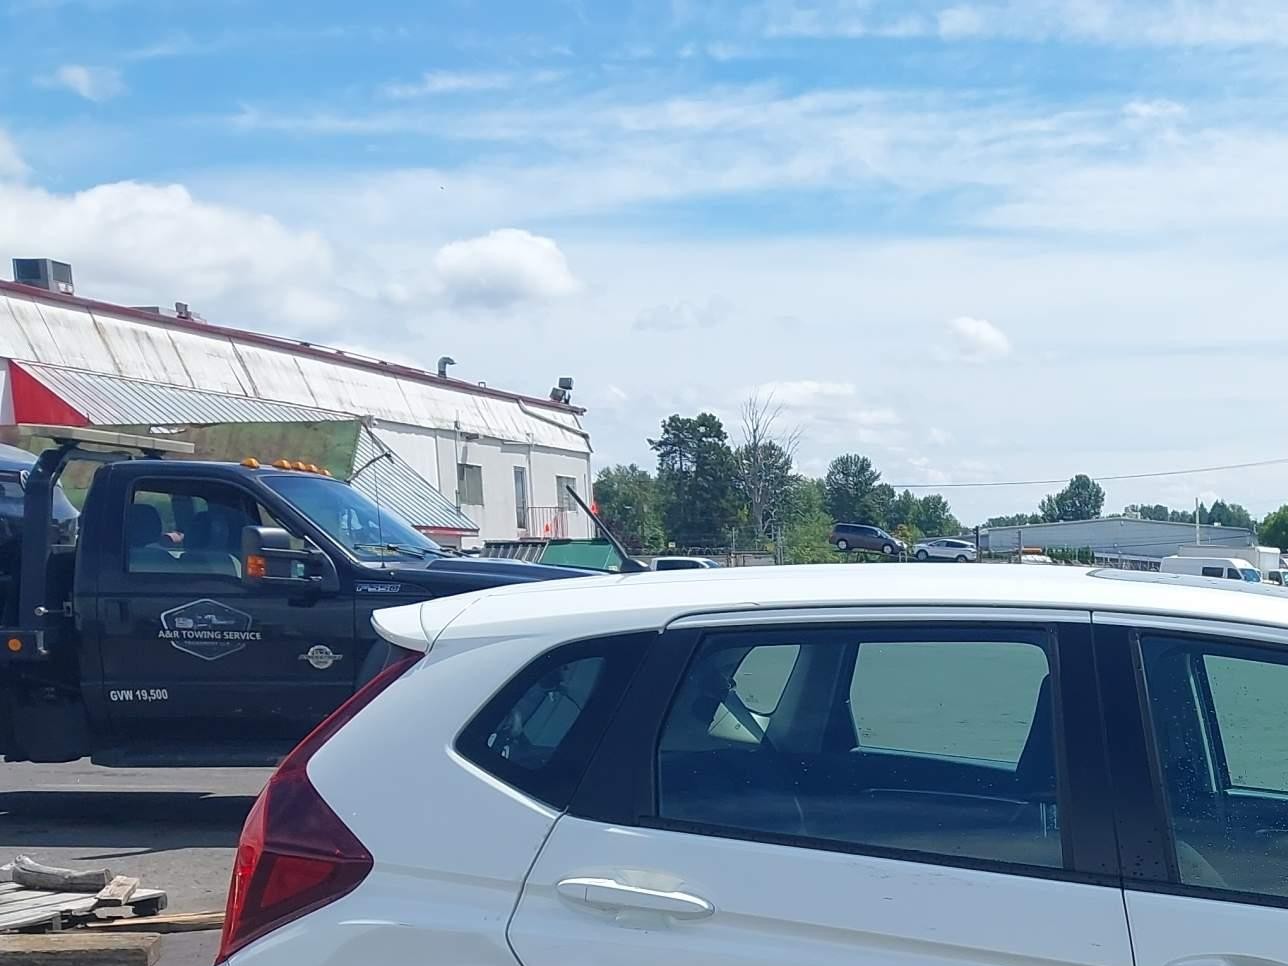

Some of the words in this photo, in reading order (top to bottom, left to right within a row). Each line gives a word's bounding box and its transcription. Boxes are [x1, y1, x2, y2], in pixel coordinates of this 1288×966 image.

[158, 630, 180, 639] A&R
[182, 630, 221, 640] TOWING
[223, 631, 262, 640] SERVICE
[110, 690, 133, 701] GVW
[135, 689, 168, 702] 19,500
